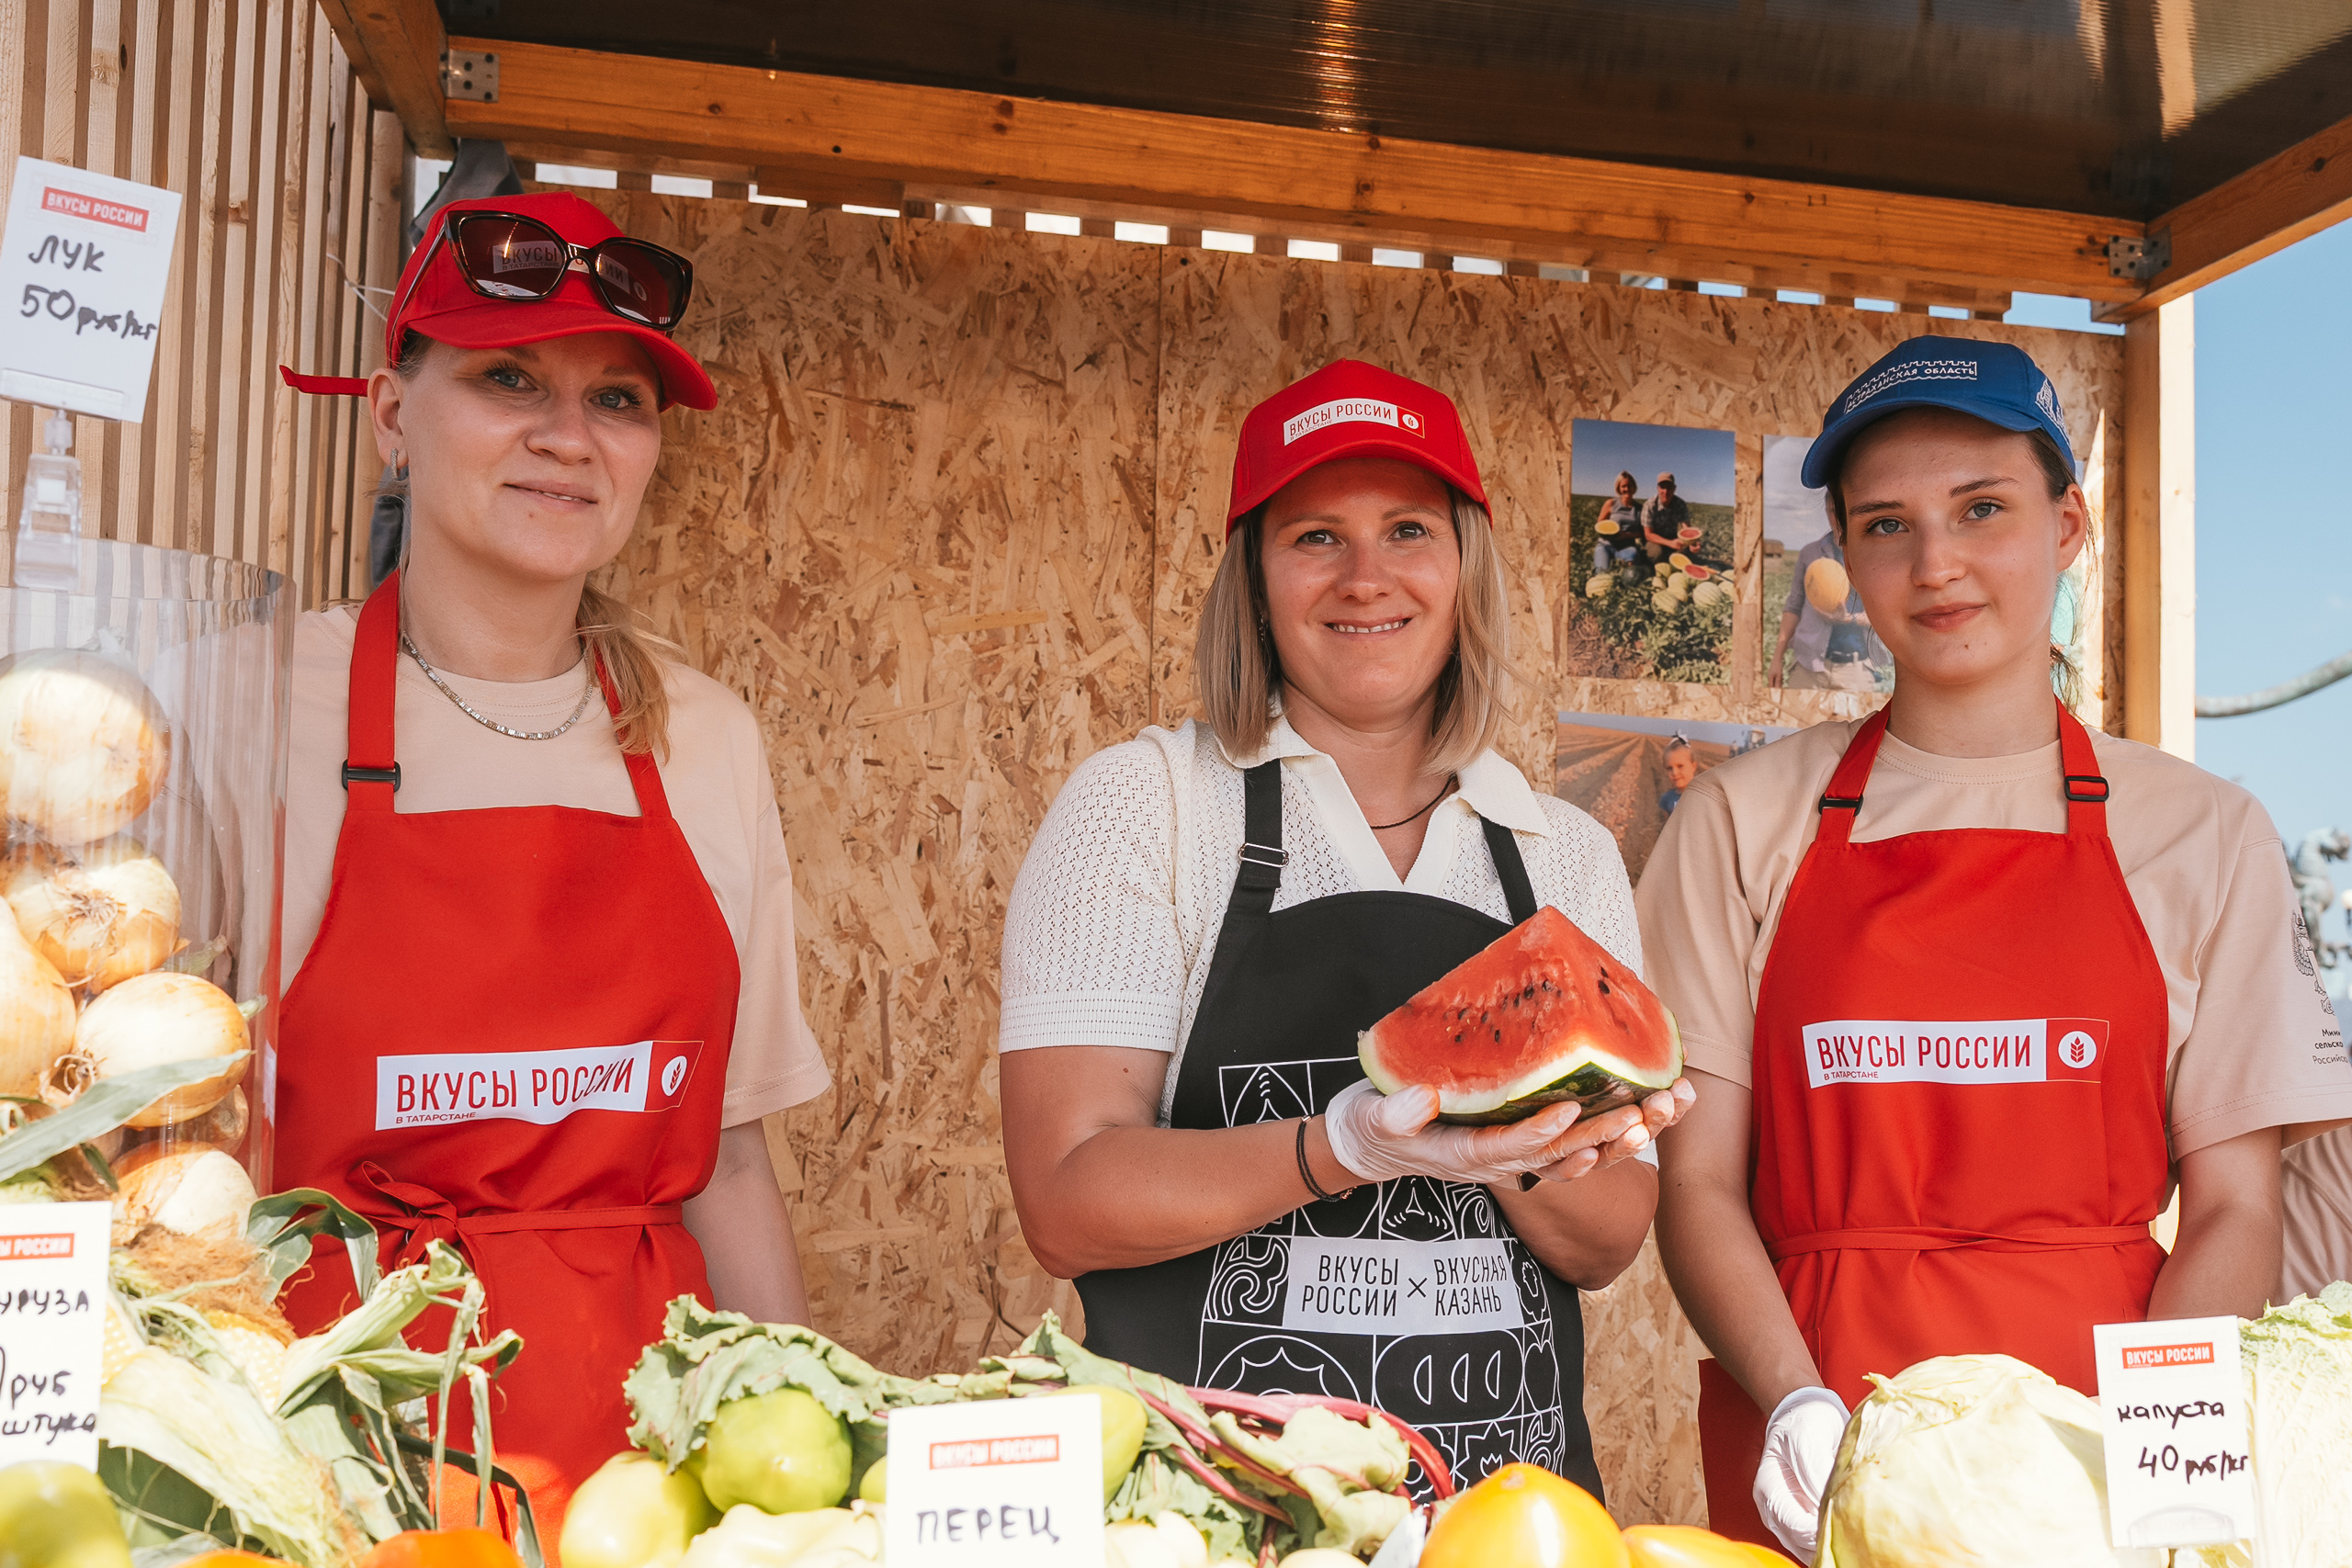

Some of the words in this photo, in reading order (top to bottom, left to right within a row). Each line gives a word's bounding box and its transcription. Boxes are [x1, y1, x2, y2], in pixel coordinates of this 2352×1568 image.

[47, 191, 91, 215] ВКУСЫ
[93, 202, 144, 227] РОССИИ
[502, 247, 558, 265] ВКУСЫ
[509, 262, 560, 270] ТАТАРСТАНЕ
[1847, 368, 1918, 410] АСТРАХАНСКАЯ
[1924, 367, 1975, 376] ОБЛАСТЬ
[1289, 408, 1331, 436] ВКУСЫ
[1336, 403, 1392, 421] РОССИИ
[1295, 419, 1333, 438] ТАТАРСТАНЕ
[1816, 1035, 1905, 1070] ВКУСЫ
[1918, 1034, 2031, 1069] РОССИИ
[396, 1070, 517, 1113] ВКУСЫ
[532, 1057, 636, 1107] РОССИИ
[1831, 1070, 1879, 1079] ТАТАРСТАНЕ
[396, 1116, 404, 1124] В
[406, 1111, 477, 1123] ТАТАРСТАНЕ
[1318, 1255, 1399, 1286] ВКУСЫ
[1433, 1255, 1508, 1286] ВКУСНАЯ
[1301, 1285, 1397, 1317] РОССИИ
[1435, 1286, 1502, 1316] КАЗАНЬ
[2126, 1349, 2164, 1365] ВКУСЫ
[2165, 1346, 2211, 1363] РОССИИ
[2117, 1401, 2225, 1429] капуста
[2138, 1444, 2179, 1477] 40
[917, 1505, 1060, 1544] ПЕРЕЦ
